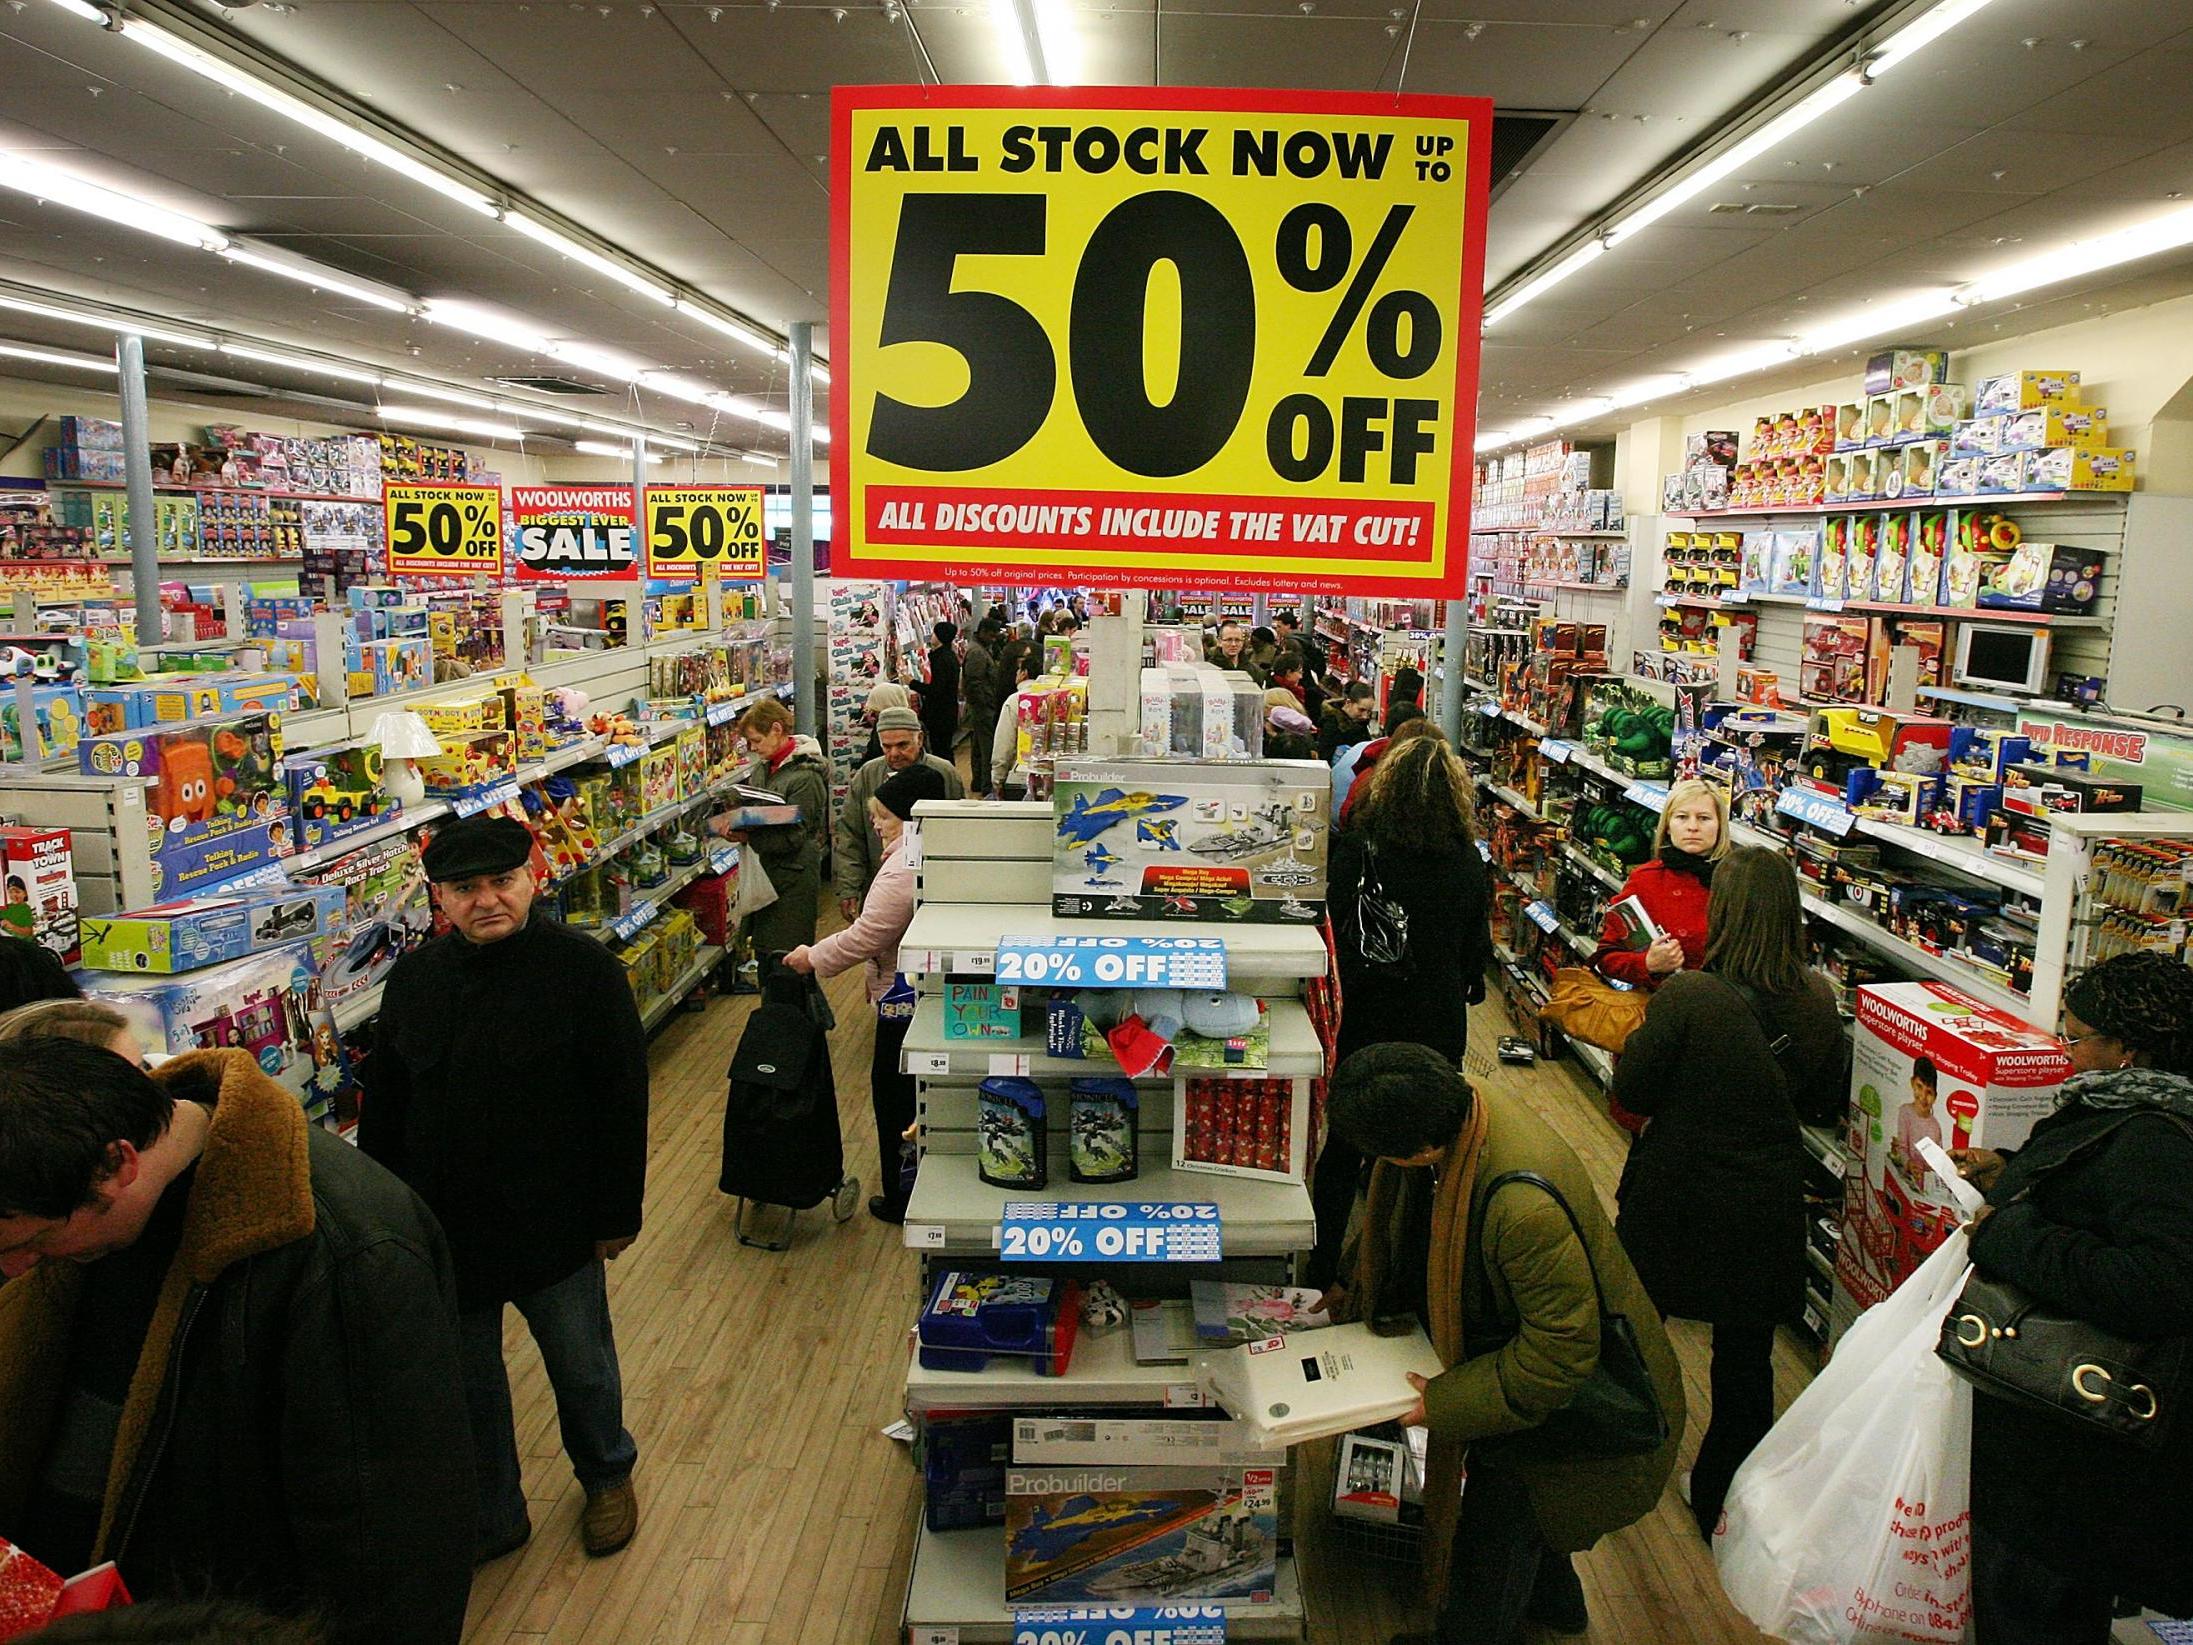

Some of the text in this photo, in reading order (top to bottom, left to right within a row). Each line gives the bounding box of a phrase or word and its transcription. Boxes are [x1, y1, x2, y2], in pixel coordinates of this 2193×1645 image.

[865, 125, 1394, 181] ALL STOCK NOW
[1415, 135, 1453, 158] UP
[1415, 160, 1451, 183] TO
[866, 189, 1443, 479] 50%
[1266, 393, 1439, 485] OFF
[390, 490, 484, 501] ALL STOCK NOW
[516, 491, 632, 507] WOOLWORTHS
[650, 494, 747, 502] ALL STOCK NOW
[392, 502, 496, 556] 50%
[520, 514, 629, 526] BIGGEST EVER
[878, 501, 1422, 547] ALL DISCOUNTS INCLUDE THE VAT CUT!
[653, 505, 759, 558] 50%
[465, 540, 497, 557] OFF
[521, 527, 633, 560] SALE
[727, 542, 759, 558] OFF
[944, 567, 1343, 591] Up to 50% off original prices. Participation by concessions is optional. Excludes lottery and news.
[1182, 605, 1213, 614] SALE
[1221, 605, 1253, 615] SALE
[2053, 723, 2147, 764] RESPONSE
[1071, 770, 1126, 781] Probuilder
[452, 797, 483, 817] 20%
[1776, 791, 1835, 823] 20% OFF
[206, 817, 231, 830] Talking
[32, 837, 65, 854] TRACK
[33, 852, 65, 869] TOWN
[204, 849, 234, 862] Talking
[321, 842, 408, 884] Deluxe Silver Hatch
[179, 867, 208, 881] Rescue
[344, 861, 391, 887] Race Track
[1056, 938, 1223, 949] 20% OFF
[998, 952, 1082, 981] 20%
[1094, 953, 1167, 982] OFF
[952, 1003, 1001, 1021] YOUR
[1861, 995, 1928, 1041] WOOLWORTHS
[952, 1023, 992, 1036] OWN
[1859, 1007, 1897, 1037] Superstore
[1897, 1028, 1923, 1054] playset
[1935, 1053, 1959, 1073] Shopping
[1959, 1065, 1979, 1082] Trolley
[1996, 1054, 2069, 1067] WOOLWORTHS
[1995, 1066, 2037, 1075] Superstore
[1176, 1159, 1186, 1168] 12
[1060, 1205, 1218, 1219] 20% OFF
[1002, 1226, 1083, 1255] 20%
[1095, 1226, 1165, 1256] OFF
[1008, 1473, 1127, 1493] Probuilder
[1244, 1498, 1271, 1509] £24.99
[1864, 1597, 1907, 1624] phone
[1910, 1611, 1926, 1625] on
